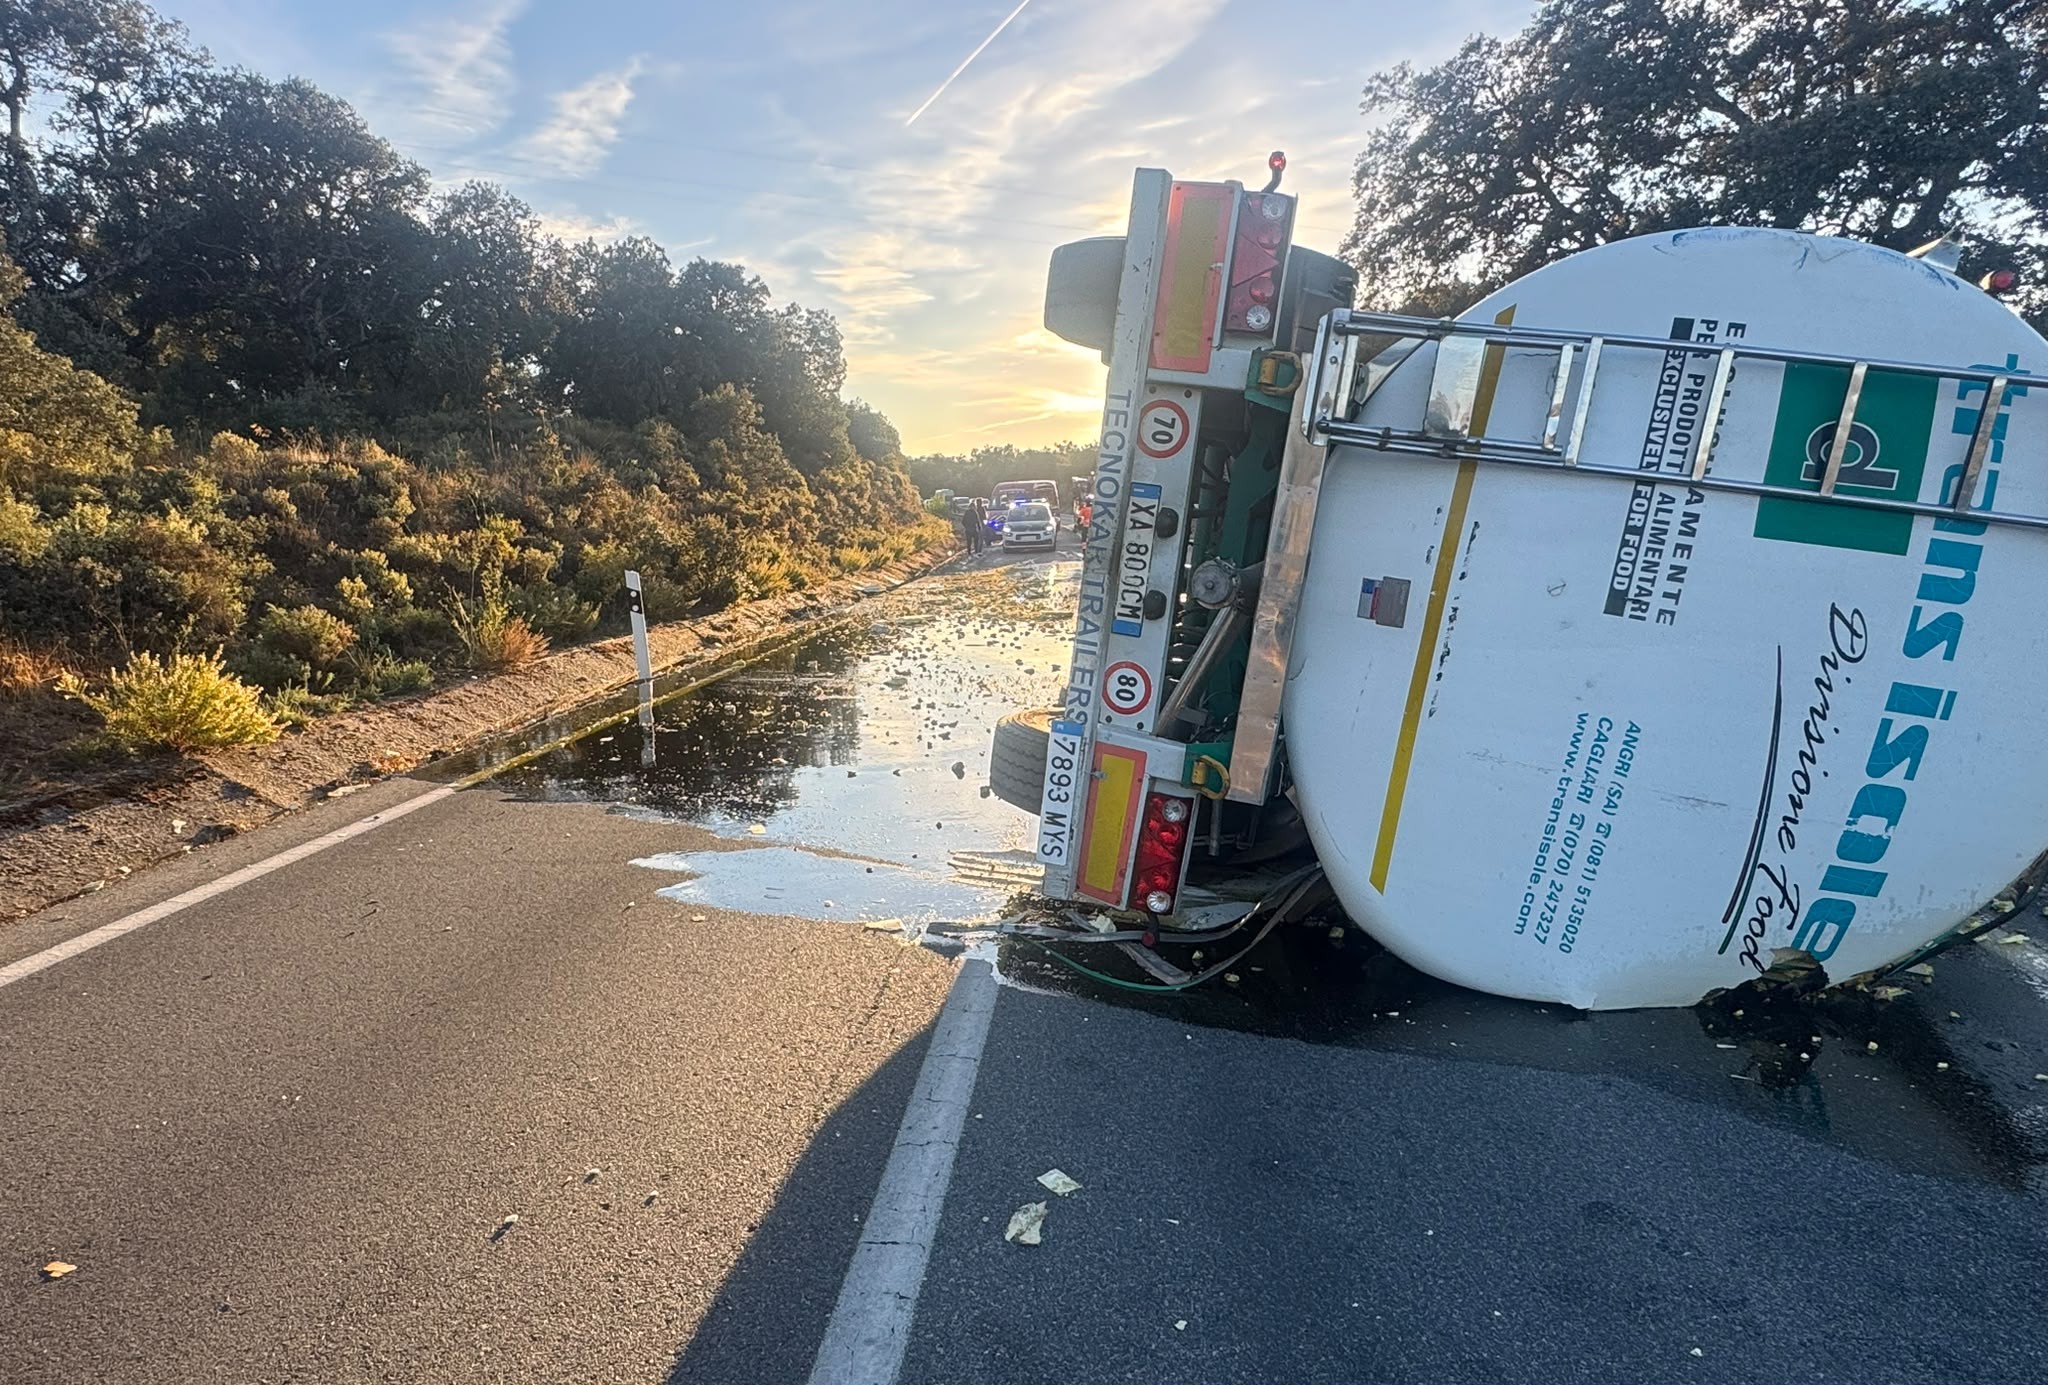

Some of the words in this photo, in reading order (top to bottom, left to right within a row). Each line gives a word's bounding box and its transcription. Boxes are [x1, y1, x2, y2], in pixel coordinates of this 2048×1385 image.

[1151, 416, 1177, 444] 70
[1666, 373, 1706, 474] PRODOTT
[1129, 501, 1157, 531] XA
[1627, 485, 1653, 528] FOR
[1117, 542, 1149, 620] 800CM
[1613, 533, 1641, 591] FOOD
[1628, 492, 1676, 622] ALIMENTARI
[1065, 574, 1106, 725] TRAILERS
[1115, 674, 1138, 702] 80
[1576, 716, 1614, 804] CAGLIARI
[1613, 719, 1642, 778] ANGRI
[1777, 602, 1869, 854] Divisione
[1048, 738, 1076, 803] 7893
[1601, 780, 1625, 816] (SA)
[1041, 813, 1068, 858] MYS
[1513, 712, 1590, 936] www.transisole.com
[1553, 829, 1580, 876] (070)
[1581, 838, 1607, 882] (081)
[1534, 879, 1564, 945] 247327
[1558, 884, 1592, 954] 5135020
[1739, 863, 1800, 974] Food
